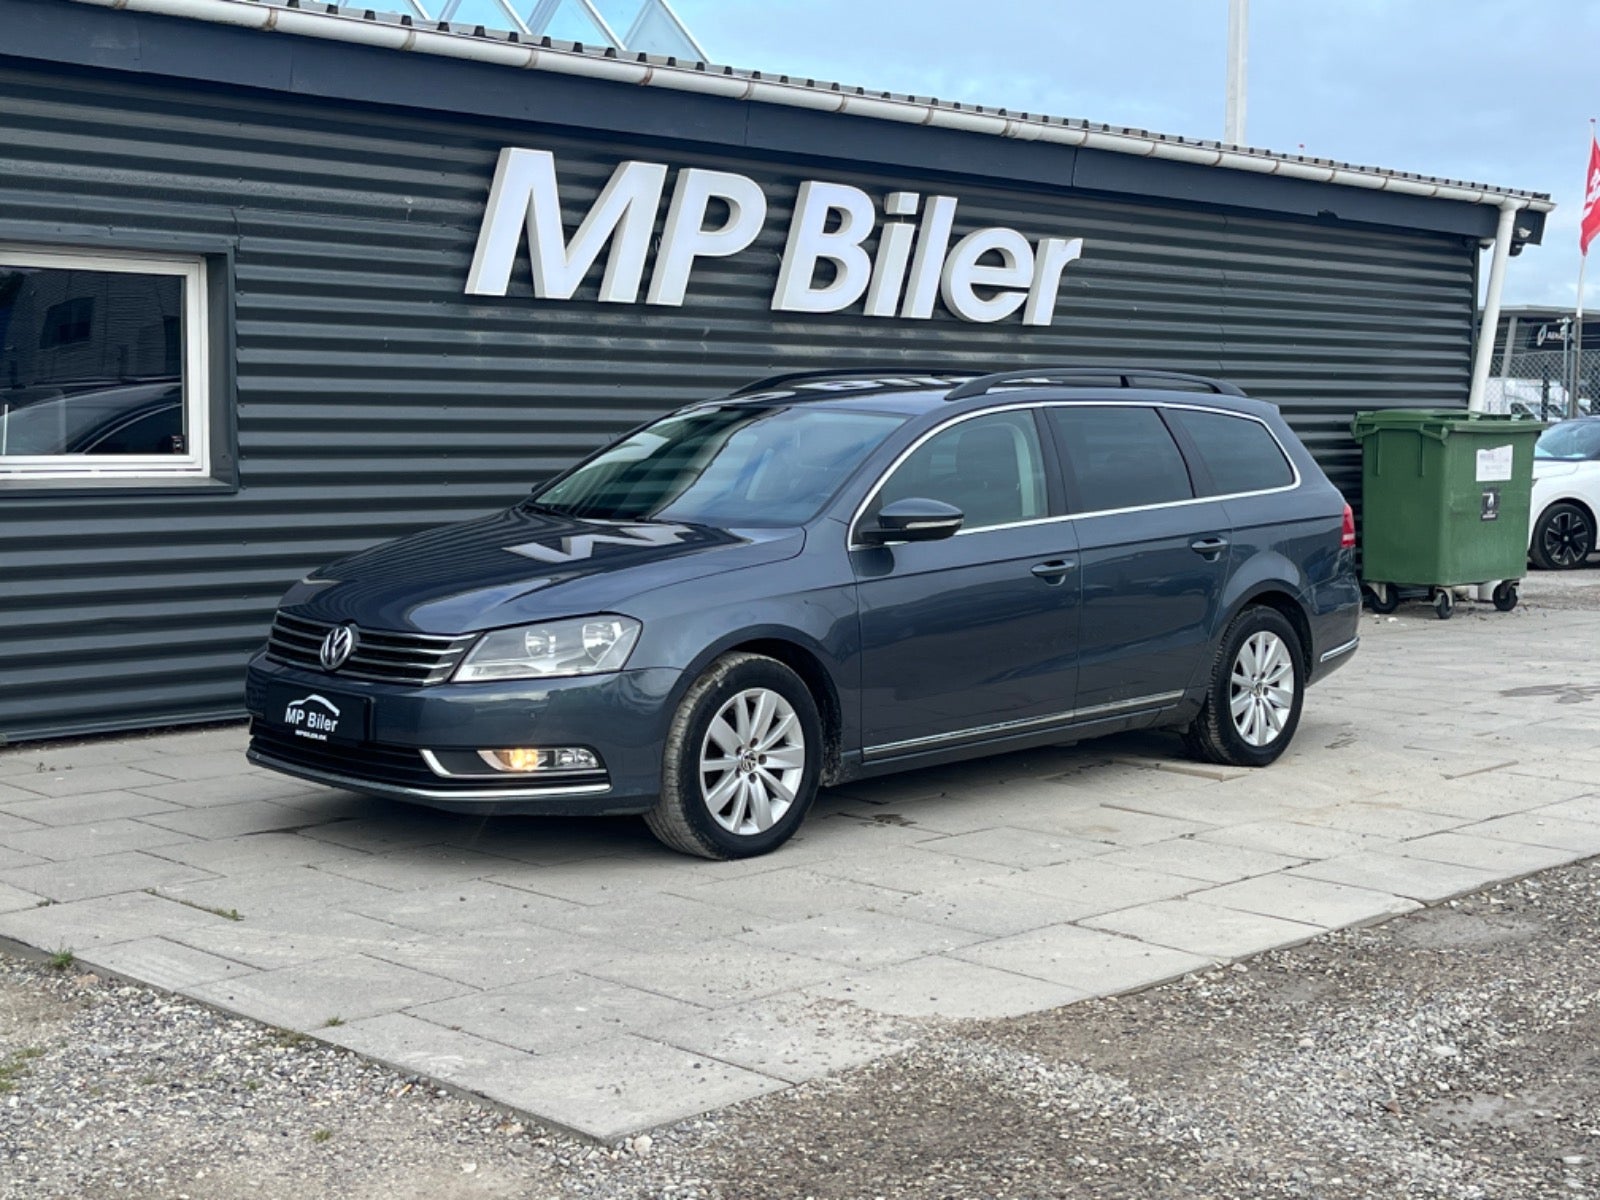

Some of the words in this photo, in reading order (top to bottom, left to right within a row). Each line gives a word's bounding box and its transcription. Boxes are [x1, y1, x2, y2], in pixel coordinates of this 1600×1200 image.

[464, 146, 768, 307] MP
[770, 180, 1083, 327] Biler
[285, 707, 305, 725] MP
[307, 711, 338, 732] Biler
